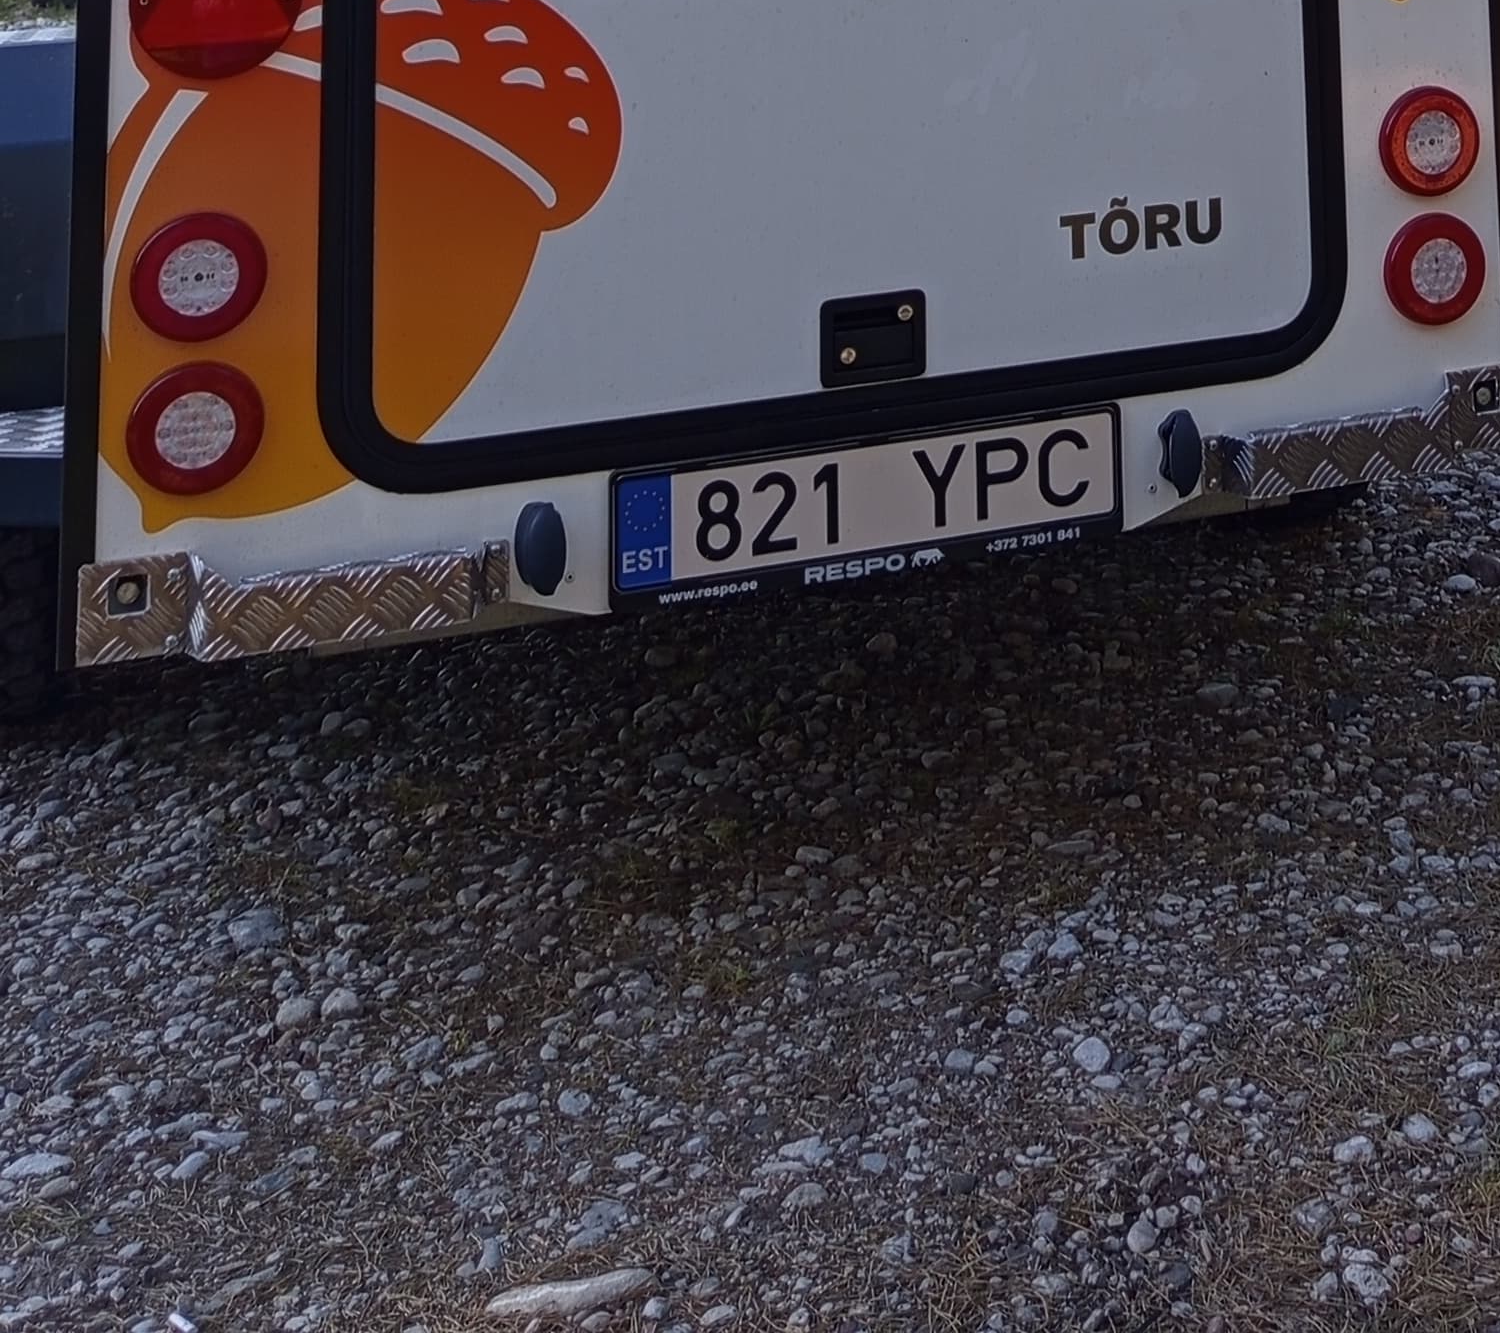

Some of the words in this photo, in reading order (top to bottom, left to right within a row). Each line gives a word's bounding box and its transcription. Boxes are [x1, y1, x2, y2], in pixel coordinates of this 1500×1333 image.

[1059, 196, 1223, 260] TÕRU
[695, 463, 840, 563] 821
[912, 428, 1091, 528] YPC
[986, 535, 1019, 553] +372
[1021, 531, 1053, 548] 7301
[1056, 527, 1081, 543] 841
[622, 545, 668, 575] EST
[804, 555, 906, 586] RESPO
[658, 579, 758, 605] www.respo.ee
